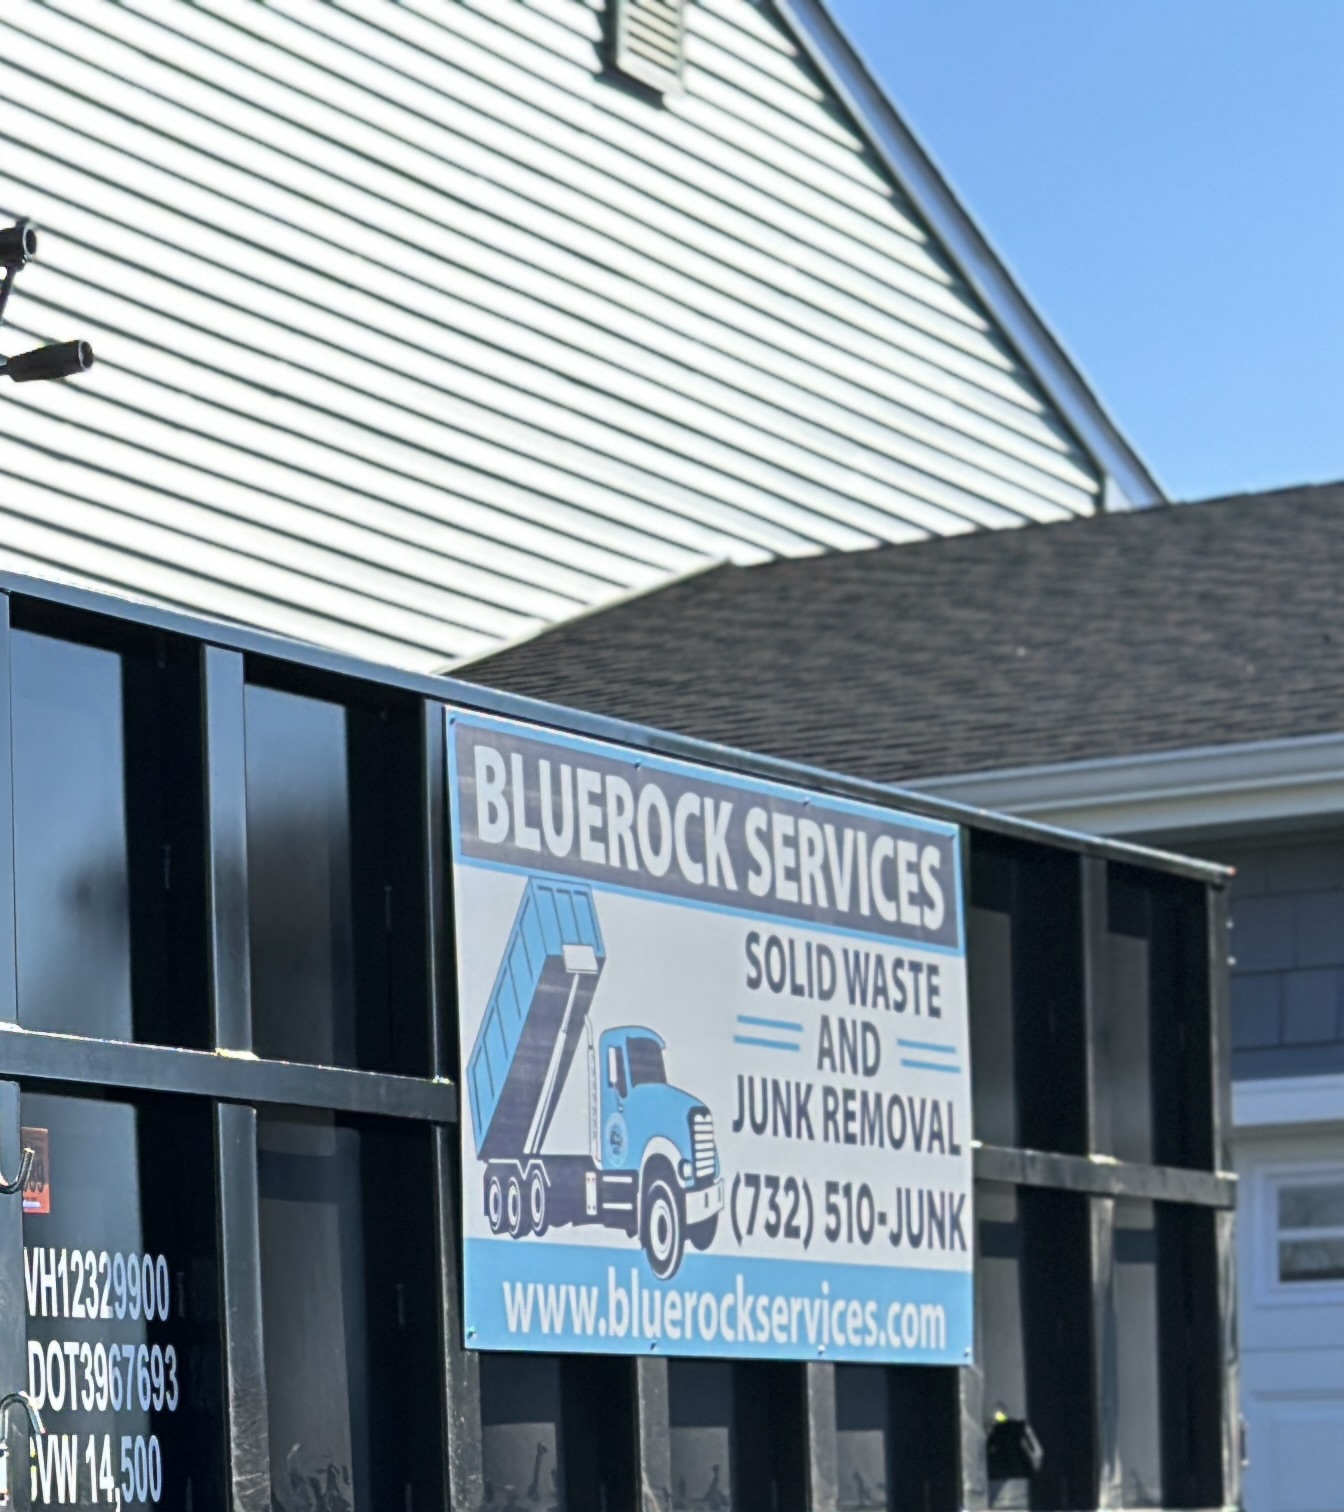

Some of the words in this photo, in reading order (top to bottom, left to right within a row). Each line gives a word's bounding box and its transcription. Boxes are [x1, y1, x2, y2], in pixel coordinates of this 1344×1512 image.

[473, 743, 737, 891] BLUEROCK
[745, 806, 945, 930] SERVICES
[745, 931, 837, 1000] SOLID
[843, 947, 943, 1018] WASTE
[817, 1014, 881, 1078] AND
[731, 1075, 815, 1140] JUNK
[824, 1089, 961, 1156] REMOVAL
[730, 1172, 813, 1249] (732)
[825, 1180, 968, 1252] 510-JUNK
[23, 1247, 170, 1322] VH12329900
[503, 1266, 945, 1349] www.bluerockservices.com
[27, 1340, 180, 1412] DOT3967693
